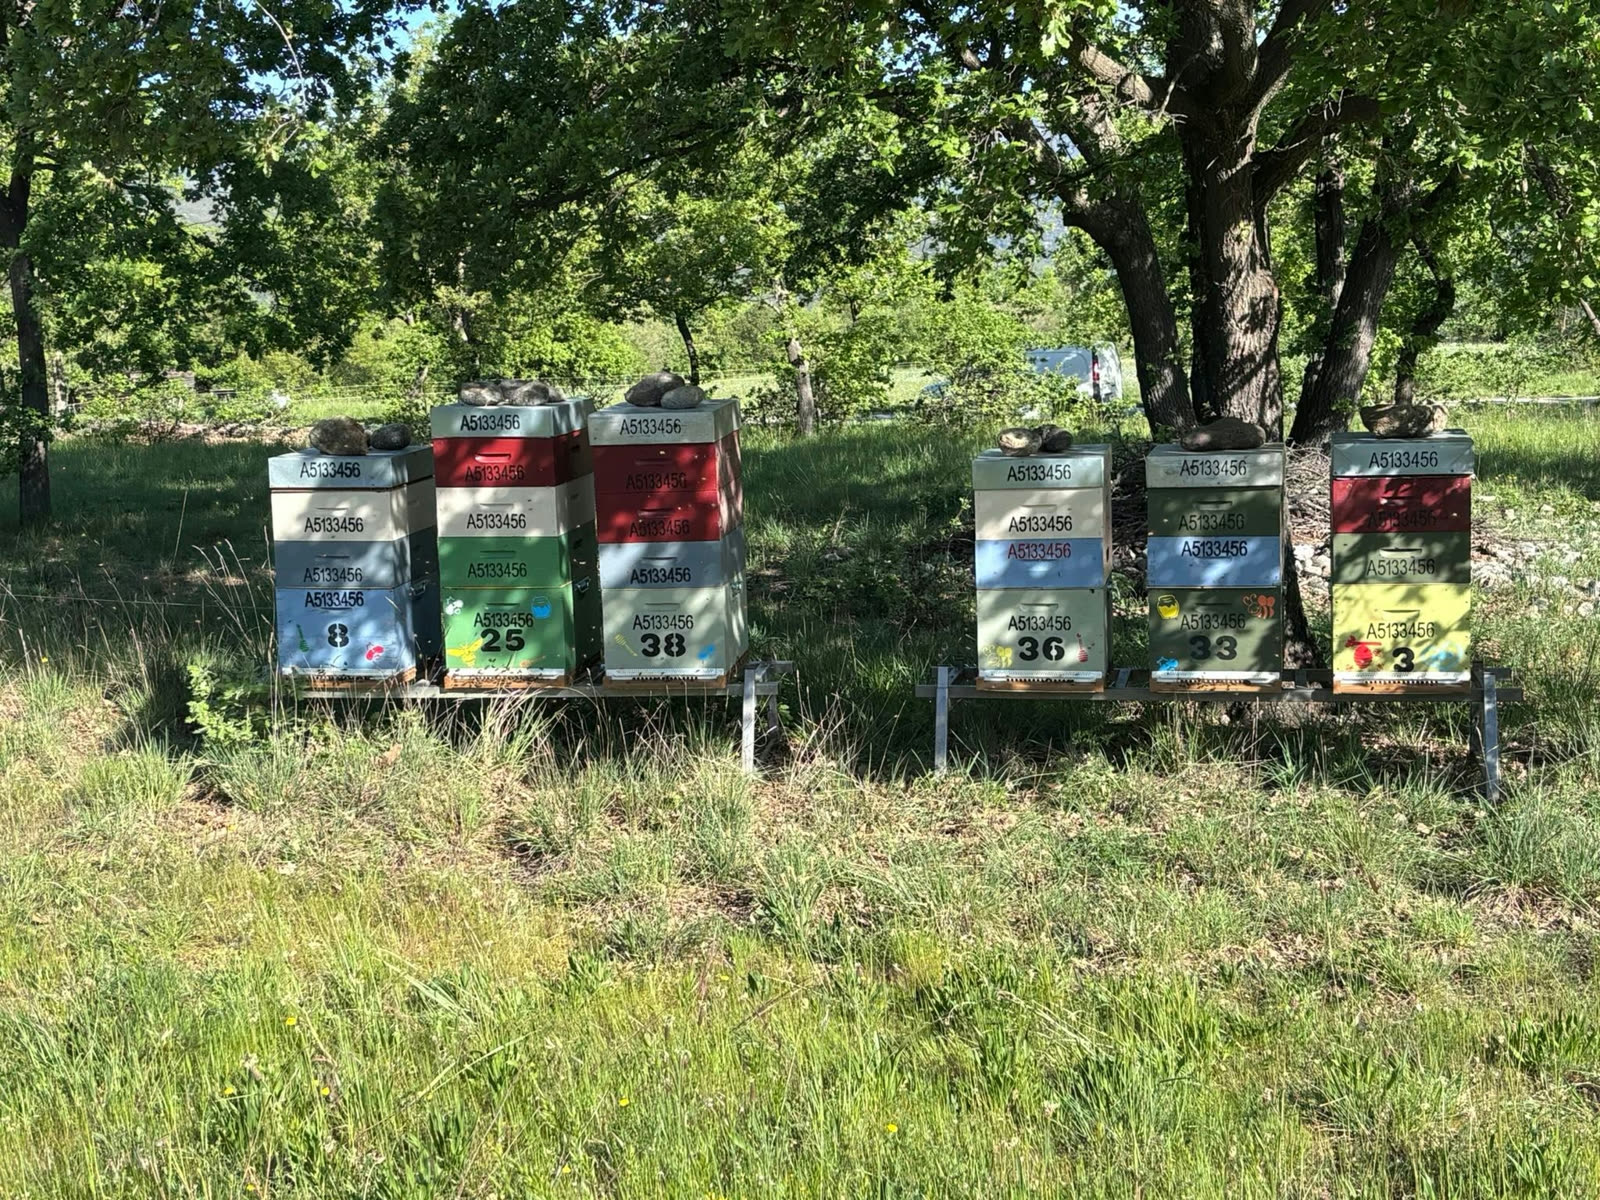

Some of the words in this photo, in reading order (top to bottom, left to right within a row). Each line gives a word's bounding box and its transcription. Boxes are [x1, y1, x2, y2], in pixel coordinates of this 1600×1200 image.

[460, 415, 520, 431] A5133456
[620, 419, 681, 435] A5133456
[1180, 460, 1246, 476] A5133456
[1369, 451, 1438, 468] A5133456
[300, 462, 361, 479] A5133456
[465, 465, 525, 481] A5133456
[1007, 464, 1071, 481] A5133456
[626, 473, 686, 490] A5133456
[304, 516, 364, 533] A5133456
[467, 514, 526, 529] A5133456
[630, 520, 690, 538] A5133456
[1009, 516, 1072, 532] A5133456
[1179, 514, 1244, 531] A5133456
[1008, 543, 1071, 559] A5133456
[1181, 541, 1247, 557] A5133456
[304, 567, 363, 583] A5133456
[468, 563, 527, 578] A5133456
[631, 568, 691, 584] A5133456
[1367, 559, 1435, 576] A5133456
[304, 591, 365, 608] A5133456
[474, 613, 533, 627] A5133456
[633, 615, 693, 630] A5133456
[1008, 616, 1071, 631] A5133456
[1180, 614, 1245, 631] A5133456
[327, 623, 349, 648] 8
[1367, 622, 1435, 639] A5133456
[481, 629, 525, 652] 25
[641, 633, 686, 657] 38
[1018, 637, 1065, 661] 36
[1189, 636, 1237, 660] 33
[1392, 647, 1415, 672] 3
